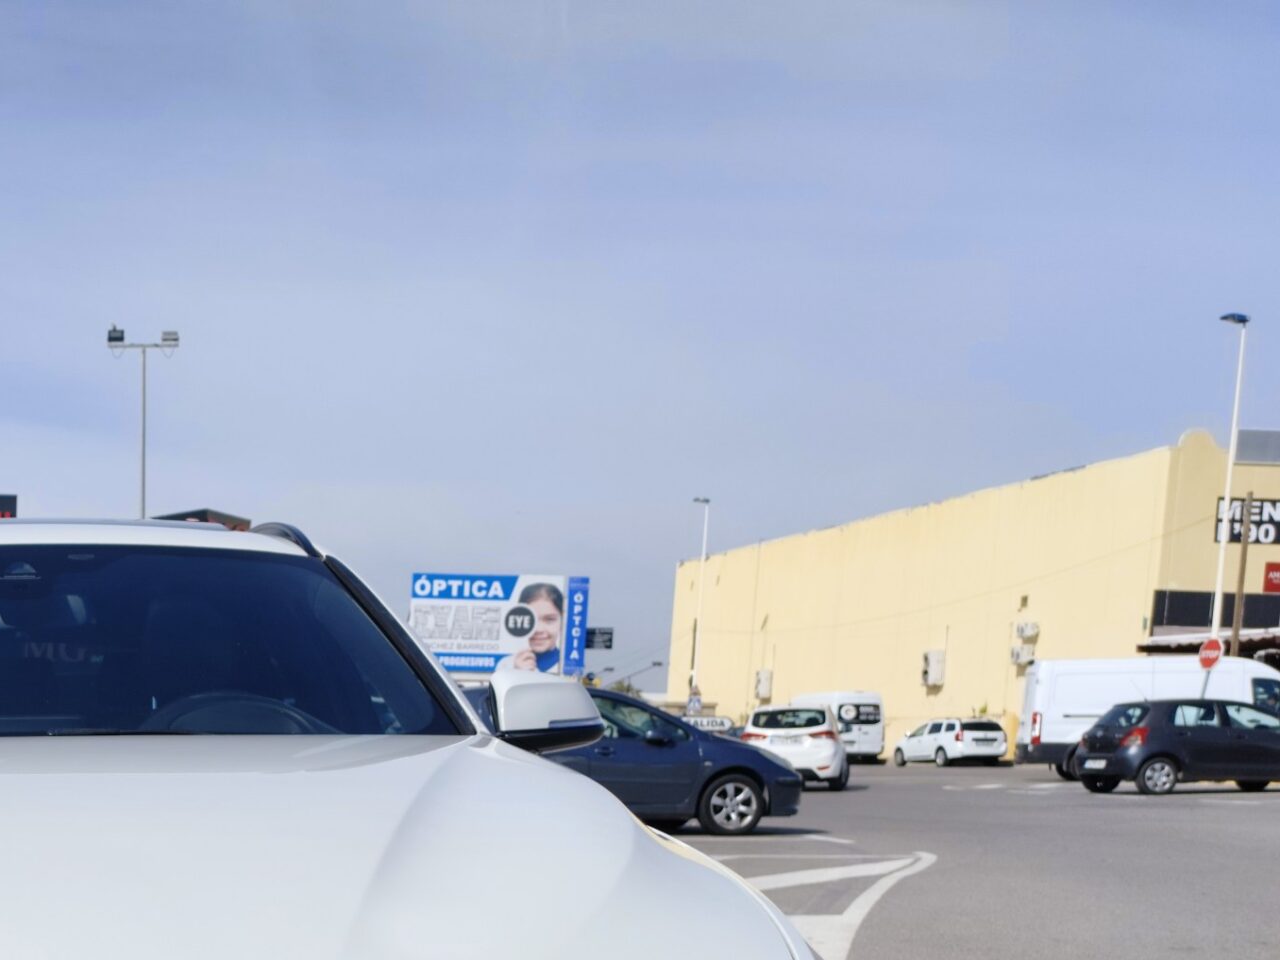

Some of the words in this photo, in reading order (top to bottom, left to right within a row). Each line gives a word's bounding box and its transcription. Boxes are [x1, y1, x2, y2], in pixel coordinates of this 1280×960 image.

[414, 575, 505, 598] ÓPTICA
[508, 615, 531, 629] EYE
[1200, 649, 1220, 659] STOP
